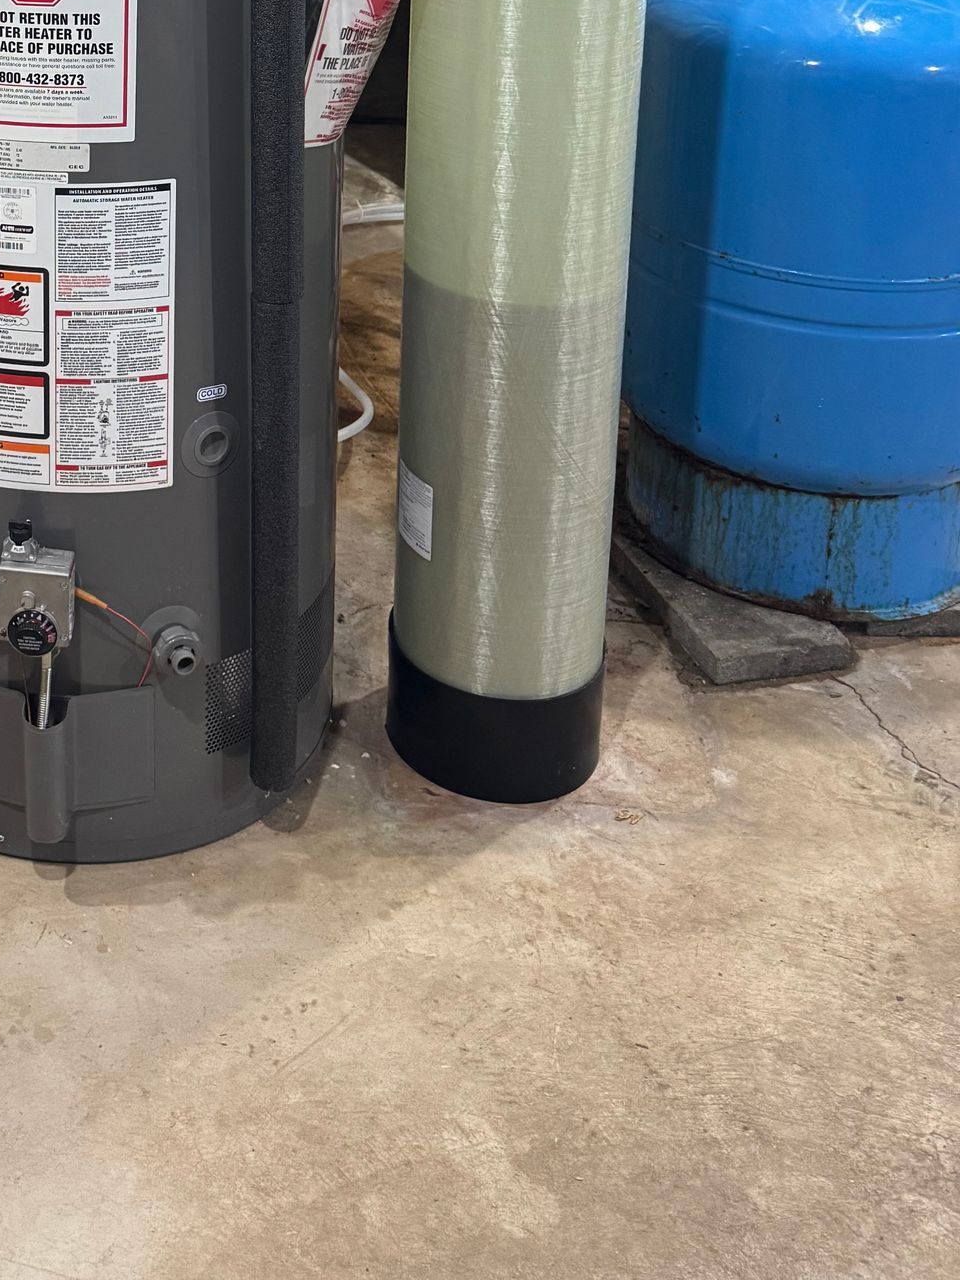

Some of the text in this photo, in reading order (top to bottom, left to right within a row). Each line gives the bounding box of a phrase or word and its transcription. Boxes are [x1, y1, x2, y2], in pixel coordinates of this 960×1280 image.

[20, 12, 68, 25] RETURN
[73, 13, 100, 25] THIS
[25, 28, 72, 40] HEATER
[76, 28, 92, 40] TO
[28, 43, 43, 54] OF
[48, 43, 114, 55] PURCHASE
[323, 57, 363, 70] THE PLACE
[201, 388, 223, 397] COLD
